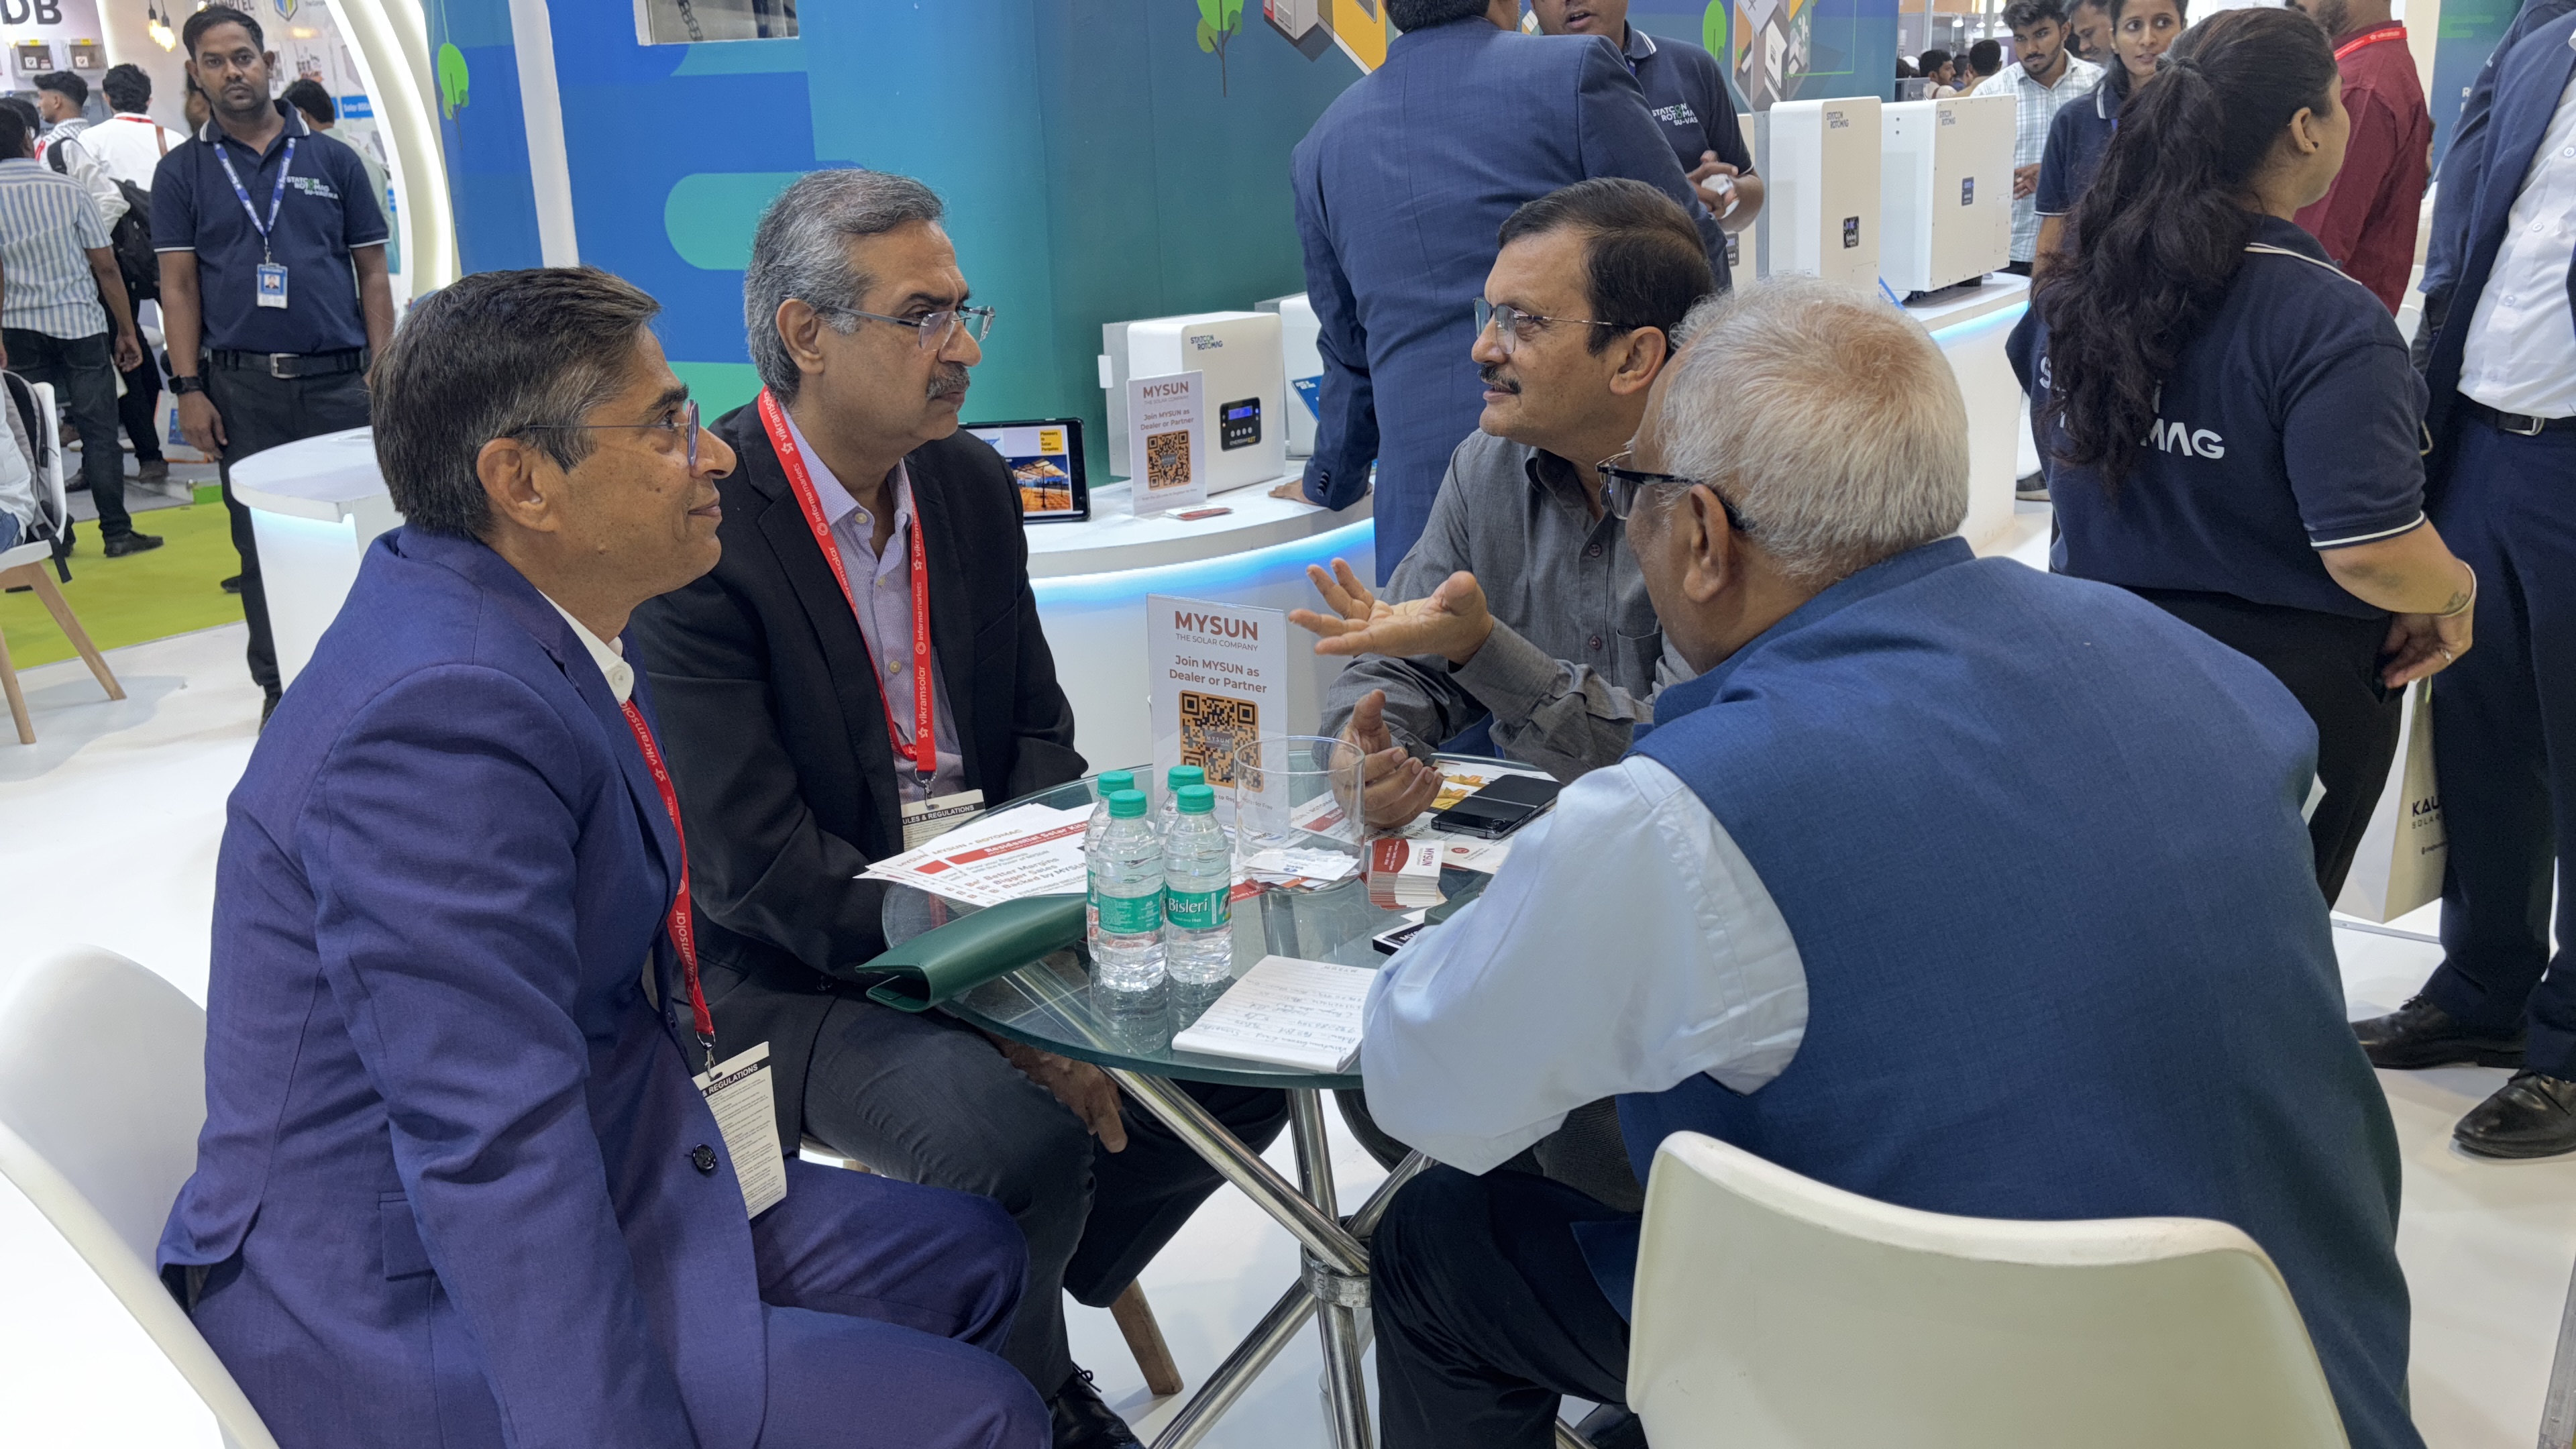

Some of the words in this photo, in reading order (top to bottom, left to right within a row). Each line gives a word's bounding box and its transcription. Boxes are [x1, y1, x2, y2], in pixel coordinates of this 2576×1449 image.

[1652, 103, 1688, 117] STATCON
[1661, 109, 1695, 121] ROTOMA
[1673, 117, 1699, 126] SU-VAS
[1190, 334, 1214, 344] STATCON
[1197, 340, 1223, 351] ROTOMAG
[1143, 381, 1189, 398] MYSUN
[763, 390, 788, 441] vikramsola
[1140, 421, 1161, 430] Dealer
[1171, 417, 1194, 426] Partner
[1143, 411, 1157, 421] Join
[1159, 409, 1181, 419] MYSUN
[1175, 610, 1258, 641] MYSUN
[1176, 633, 1191, 642] THE
[1192, 635, 1218, 646] SOLAR
[1219, 639, 1258, 651] COMPANY
[1175, 655, 1199, 667] Join
[1202, 659, 1244, 675] MYSUN
[1246, 668, 1260, 677] as
[1169, 669, 1205, 684] Dealer
[1208, 677, 1221, 686] or
[1224, 678, 1267, 694] Partner
[917, 665, 928, 725] vikramsolar
[619, 702, 657, 765] vikramsola
[1205, 736, 1231, 744] MYSUN
[902, 815, 920, 824] ULES
[927, 804, 975, 820] REGULATIONS
[983, 835, 1042, 853] Residential
[1040, 828, 1067, 839] Solar
[1067, 822, 1087, 830] Kits
[932, 843, 967, 855] MYSUN
[1421, 847, 1435, 866] MYSUN
[983, 869, 1017, 881] Better
[1018, 857, 1060, 871] Margins
[993, 873, 1026, 885] Bigger
[1028, 864, 1058, 875] Sales
[1002, 876, 1041, 889] Backed
[1168, 898, 1208, 913] Bisleri
[675, 910, 694, 983] vikramsolar
[702, 1089, 708, 1097] &
[708, 1063, 759, 1094] REGULATIONS
